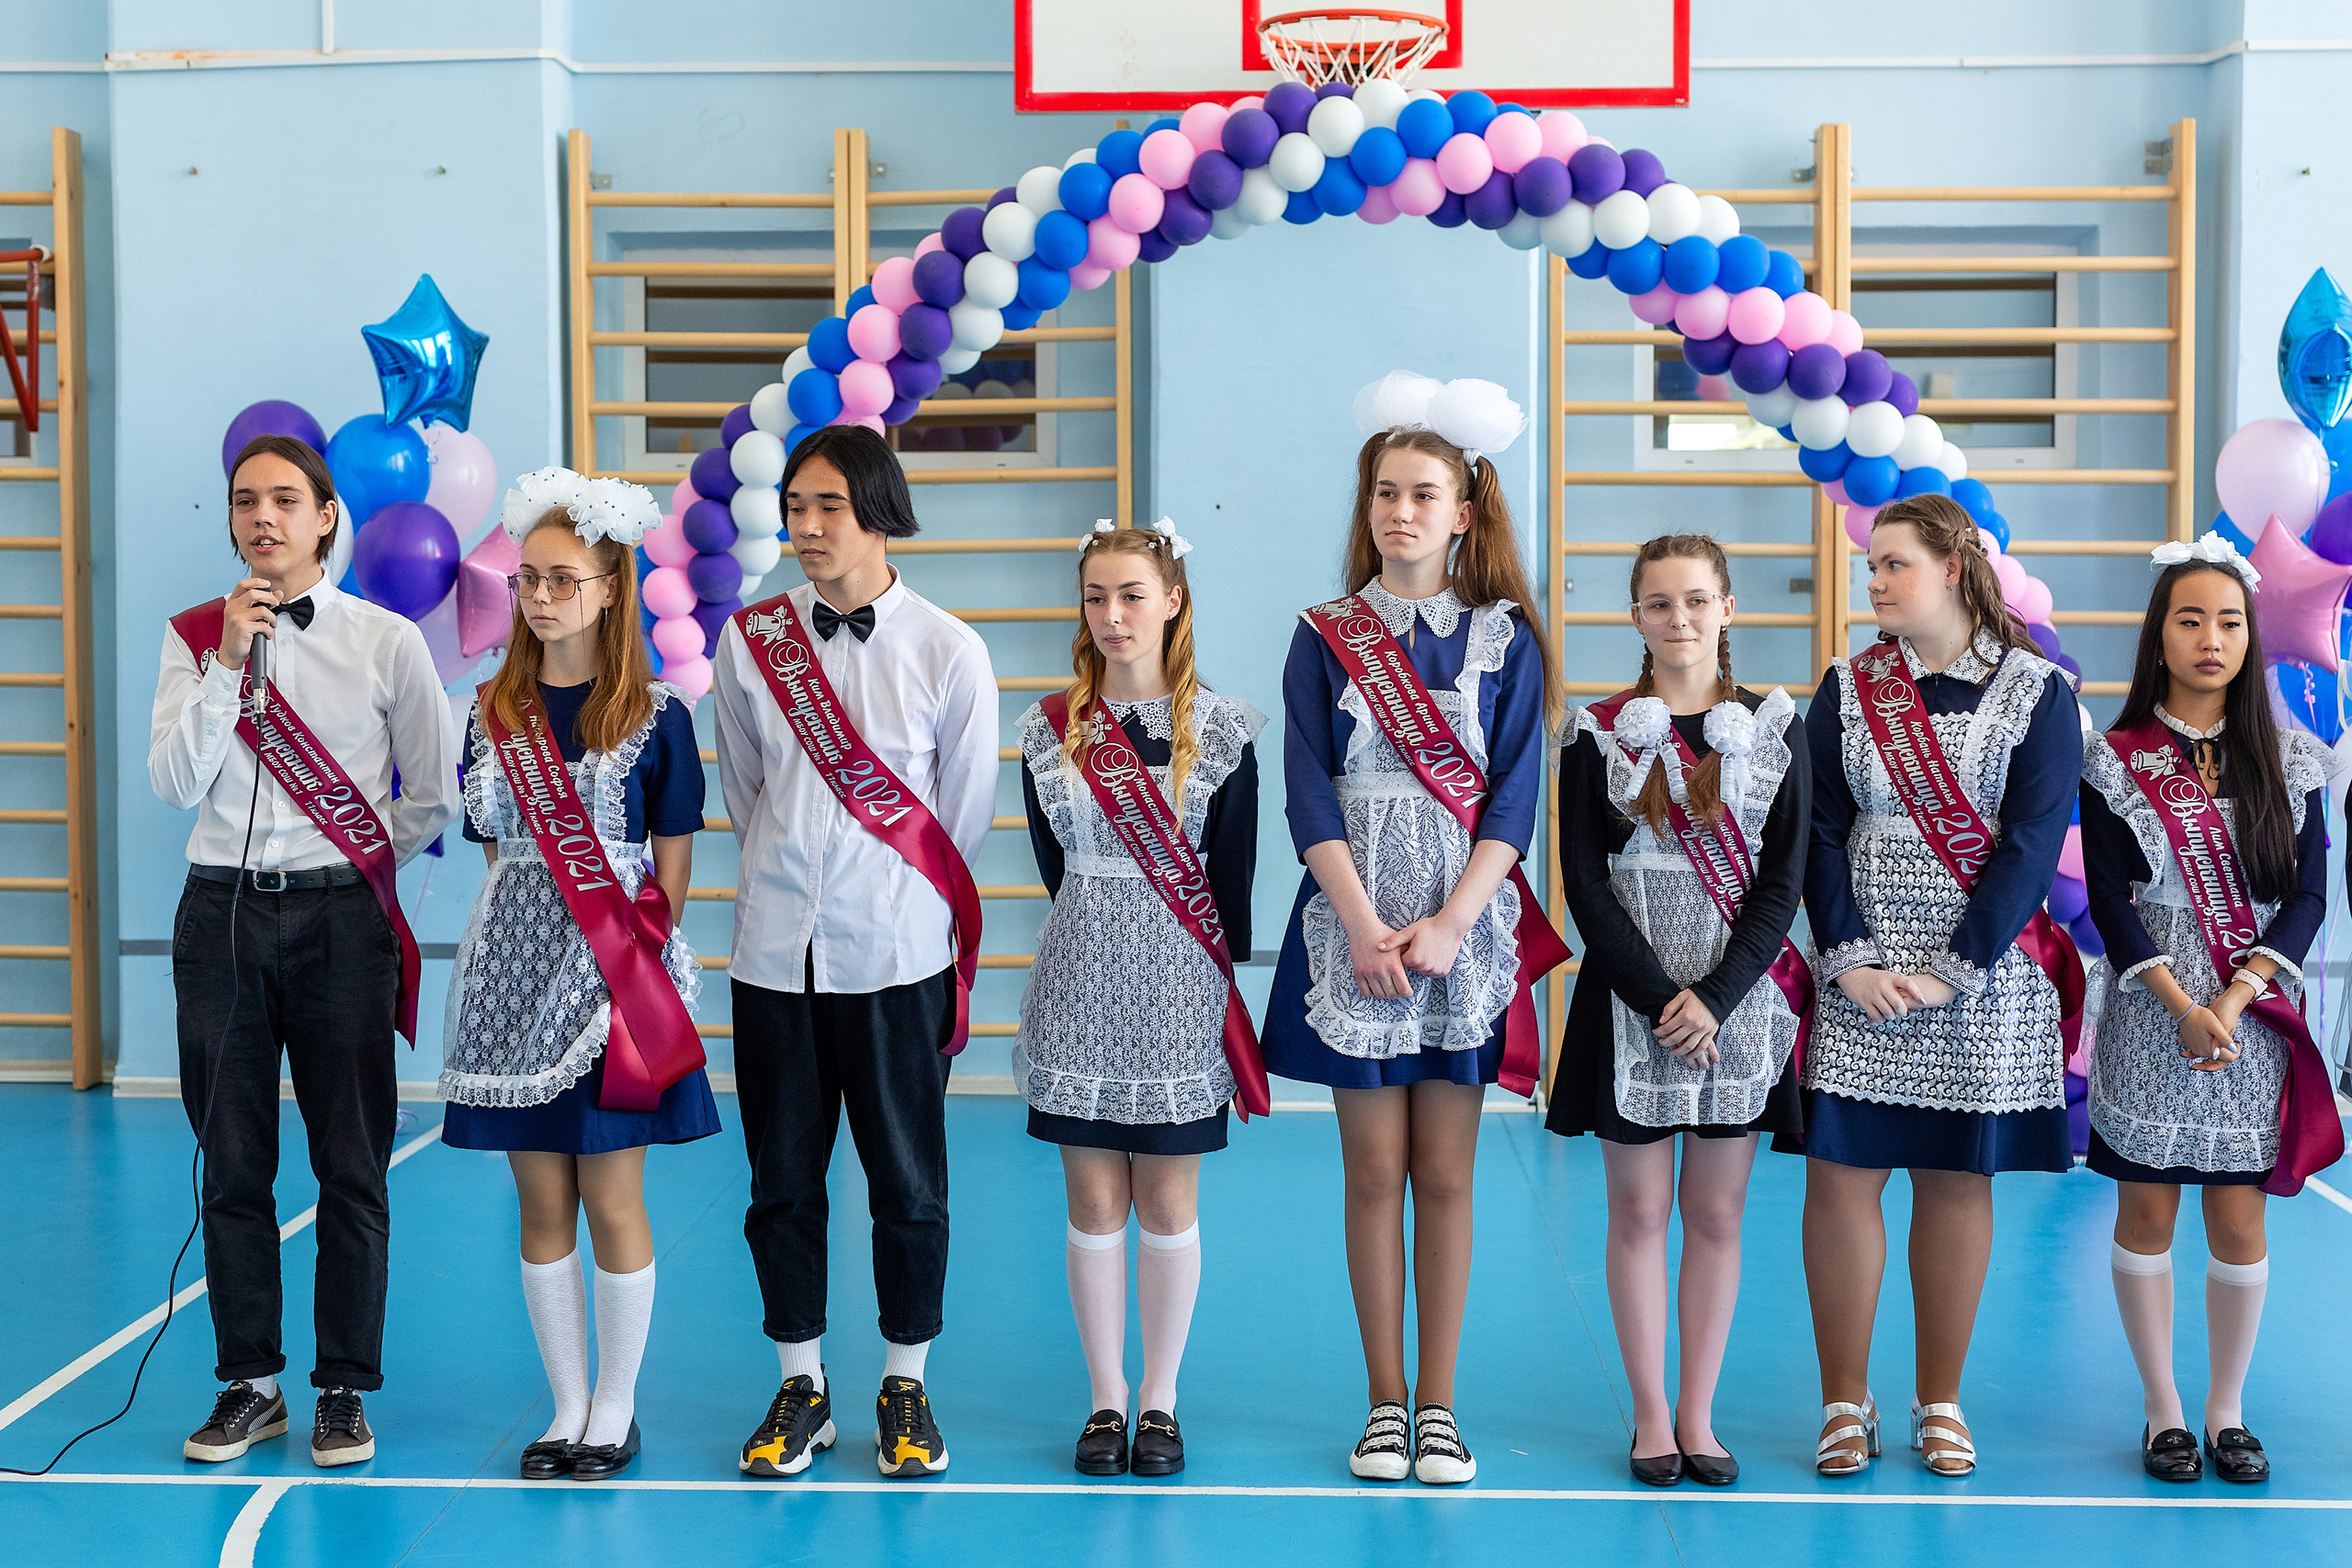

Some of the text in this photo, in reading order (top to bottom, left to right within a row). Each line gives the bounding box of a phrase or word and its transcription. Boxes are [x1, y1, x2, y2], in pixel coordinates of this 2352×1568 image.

[768, 638, 913, 827] Выпускник 2021
[808, 678, 853, 750] Ким Владимир
[1337, 615, 1487, 809] Выпускница 2021
[1363, 683, 1379, 703] МБОУ
[1375, 702, 1388, 719] СОШ
[1395, 739, 1416, 767] 11класс
[1385, 649, 1440, 734] Коробкова Арина
[270, 703, 340, 784] Гудков Константин
[503, 750, 516, 770] МБОУ
[509, 769, 522, 786] СОШ
[548, 765, 569, 798] Софья
[793, 717, 809, 737] МБОУ
[804, 736, 818, 752] СОШ
[825, 772, 847, 799] 11класс
[1871, 675, 1944, 815] Выпускница
[1910, 720, 1957, 807] Корбань Наталья
[264, 752, 282, 770] МБОУ
[277, 768, 294, 786] СОШ
[305, 800, 328, 826] 11класс
[314, 785, 387, 854] 2021
[526, 807, 544, 834] 11класс
[1134, 778, 1196, 873] Монастырная Дарья
[1883, 750, 1899, 772] МБОУ
[1894, 770, 1906, 787] СОШ
[1914, 806, 1932, 834] 11класс
[545, 814, 613, 892] 2021
[1091, 742, 1225, 945] Выпускница 2021
[1118, 823, 1137, 844] МБОУ
[1129, 843, 1146, 862] СОШ
[1153, 876, 1174, 903] 11класс
[1685, 840, 1702, 858] МБОУ
[1696, 858, 1710, 874] СОШ
[1716, 895, 1734, 922] 11класс
[1734, 852, 1752, 891] Наталья
[2159, 775, 2233, 928] Выпускница
[2209, 826, 2244, 908] Лим Светлана
[2180, 855, 2195, 877] МБОУ
[2188, 875, 2199, 896] СОШ
[2202, 915, 2218, 946] 11класс
